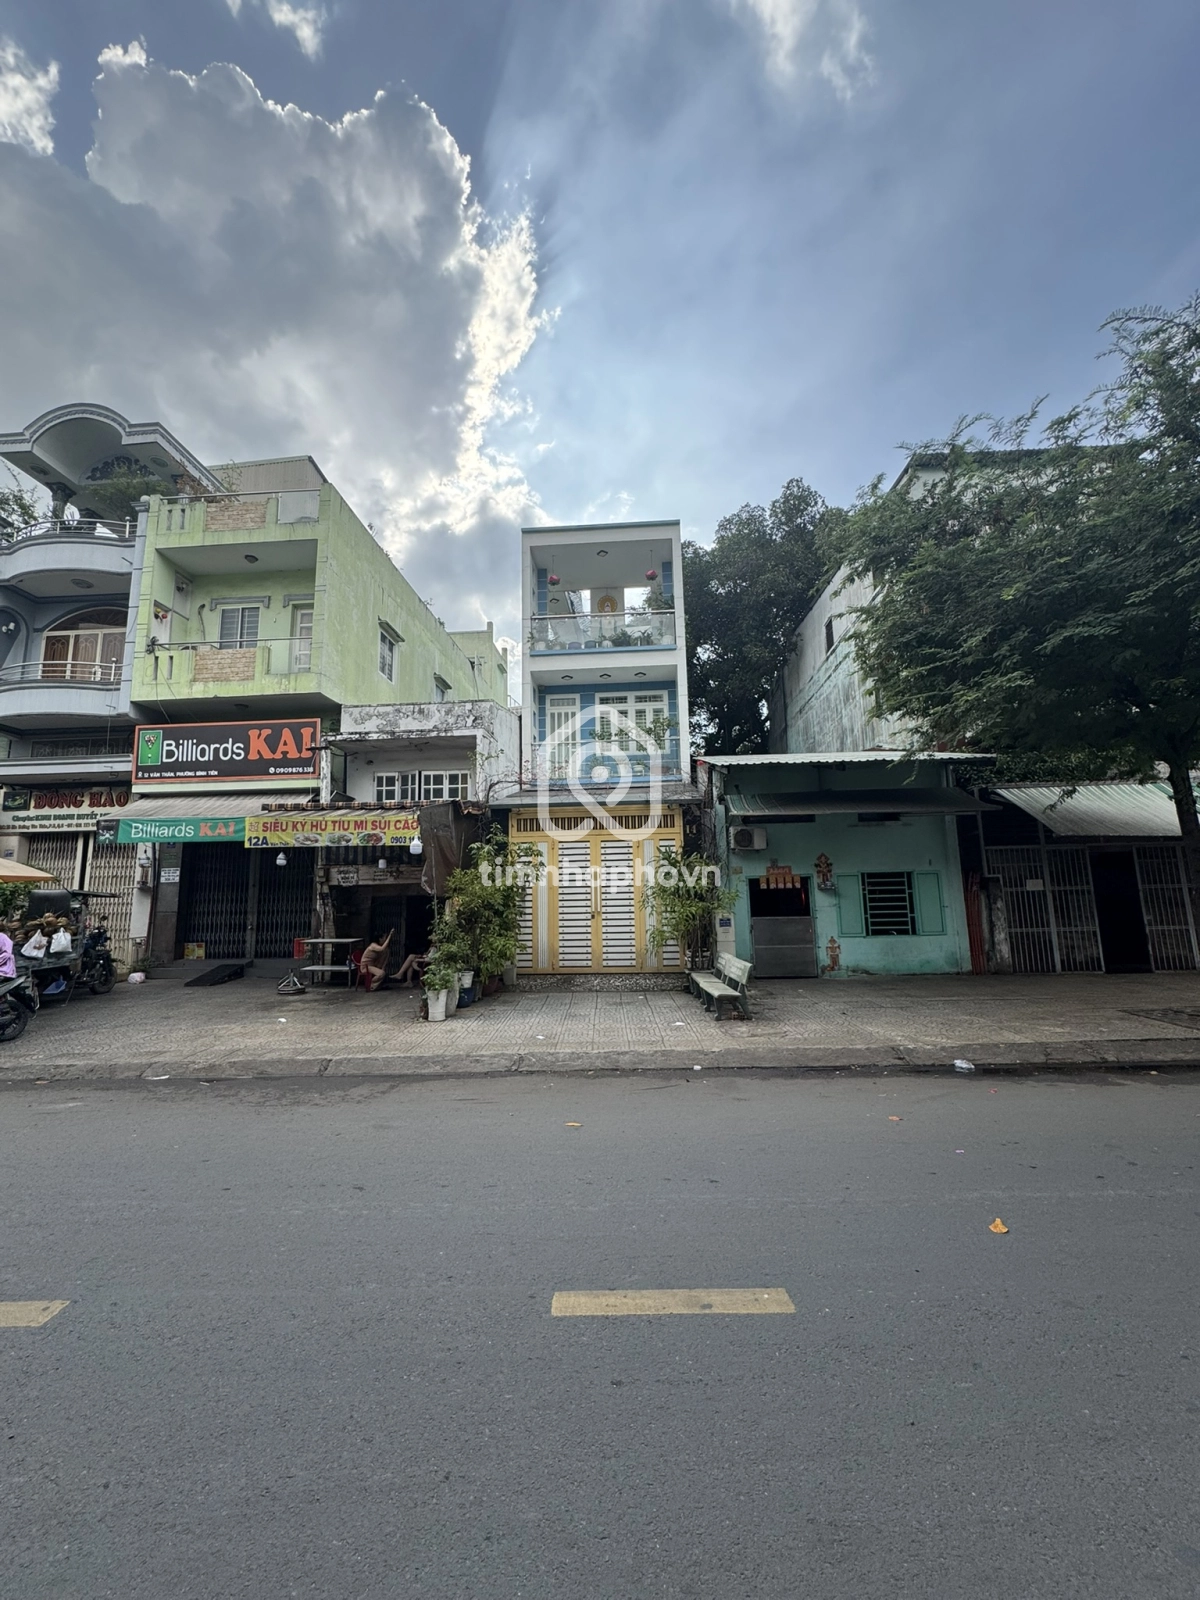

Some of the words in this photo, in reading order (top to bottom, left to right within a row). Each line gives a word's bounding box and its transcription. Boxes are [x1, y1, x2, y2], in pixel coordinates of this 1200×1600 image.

[162, 738, 244, 762] Billiards
[247, 727, 314, 760] KAI
[131, 822, 194, 838] Billiards
[199, 821, 236, 837] KAI
[262, 818, 288, 832] SIÊU
[291, 818, 307, 832] KÝ
[310, 817, 328, 832] HỦ
[331, 817, 350, 831] TÍU
[247, 835, 269, 846] 12A
[390, 835, 407, 844] 0903
